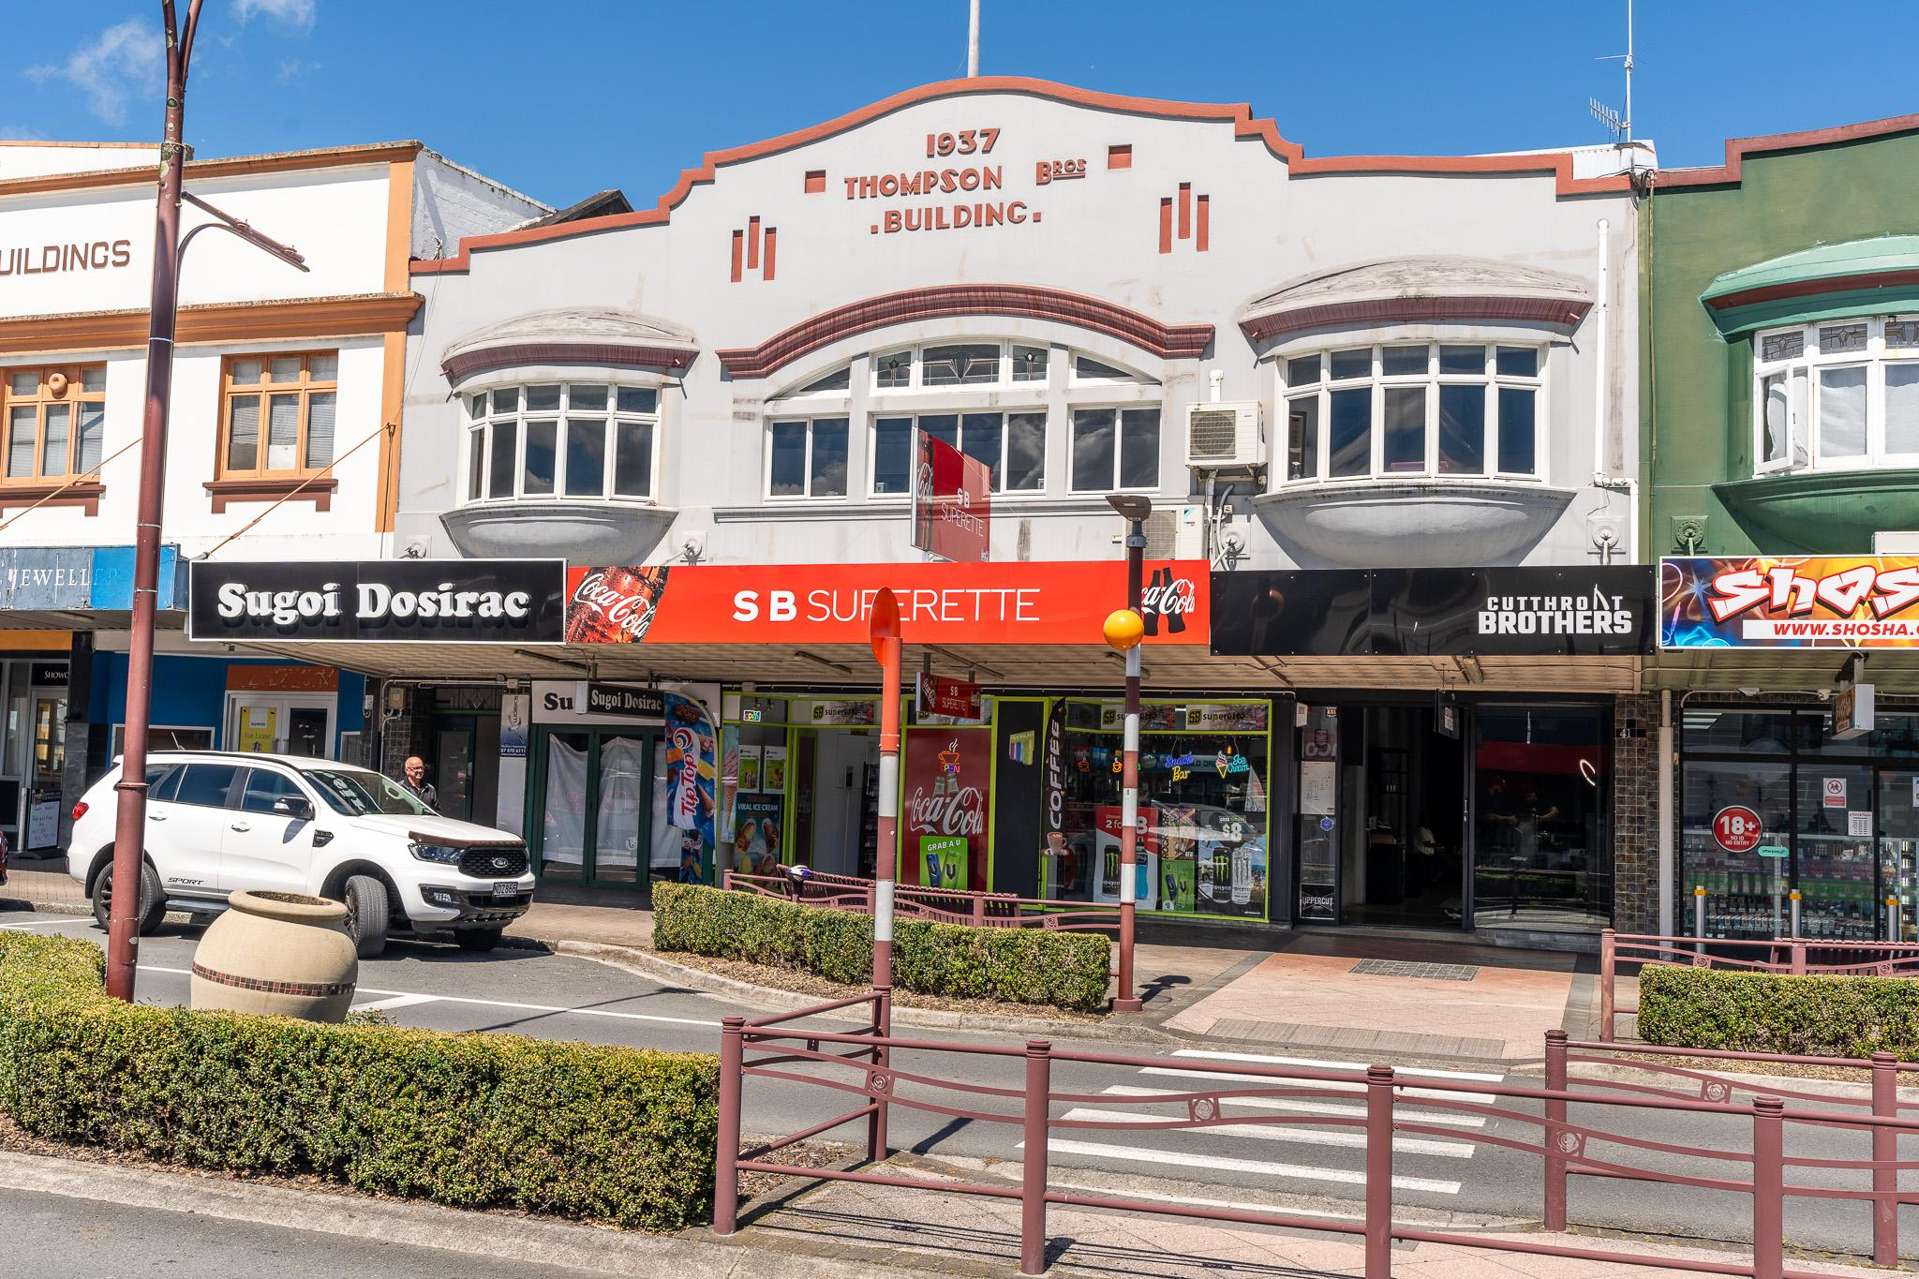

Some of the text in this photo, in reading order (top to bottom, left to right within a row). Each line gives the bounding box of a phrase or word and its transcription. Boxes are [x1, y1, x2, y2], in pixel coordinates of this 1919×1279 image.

[926, 127, 1001, 158] 1937
[844, 165, 1002, 200] THOMPSON
[942, 502, 984, 536] SUPERETTE
[217, 582, 531, 625] Sugoi Dosirac
[1141, 578, 1195, 615] ca-Cola
[1478, 611, 1632, 635] BROTHERS
[591, 690, 621, 710] Sugoi
[680, 752, 698, 785] Top
[1050, 719, 1062, 829] COFFEE
[680, 787, 699, 816] Tip
[911, 787, 984, 835] Coca-Cola
[1105, 819, 1112, 828] 2
[1136, 816, 1148, 835] 8
[1720, 815, 1756, 835] 18+
[927, 841, 947, 852] GRAB
[167, 877, 204, 885] SPORT
[1302, 896, 1333, 906] UPPERCUT
